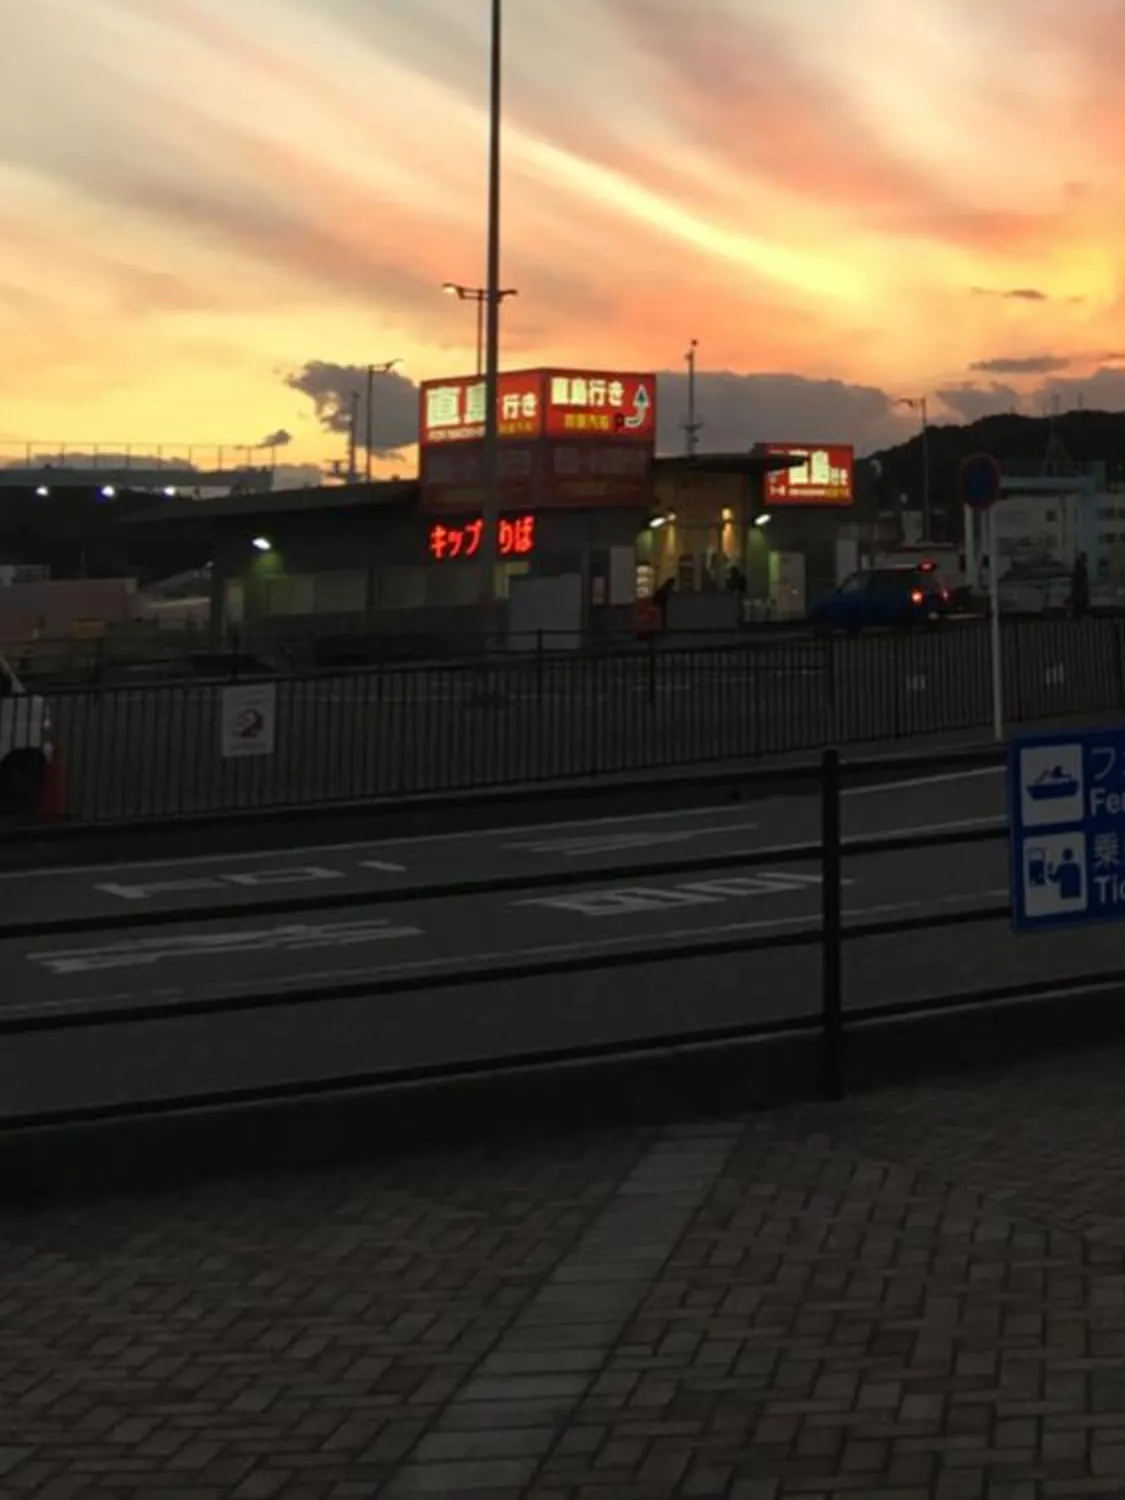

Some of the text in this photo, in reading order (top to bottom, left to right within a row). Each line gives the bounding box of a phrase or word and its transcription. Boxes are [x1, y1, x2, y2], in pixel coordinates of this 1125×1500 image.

[430, 514, 535, 560] キップりば
